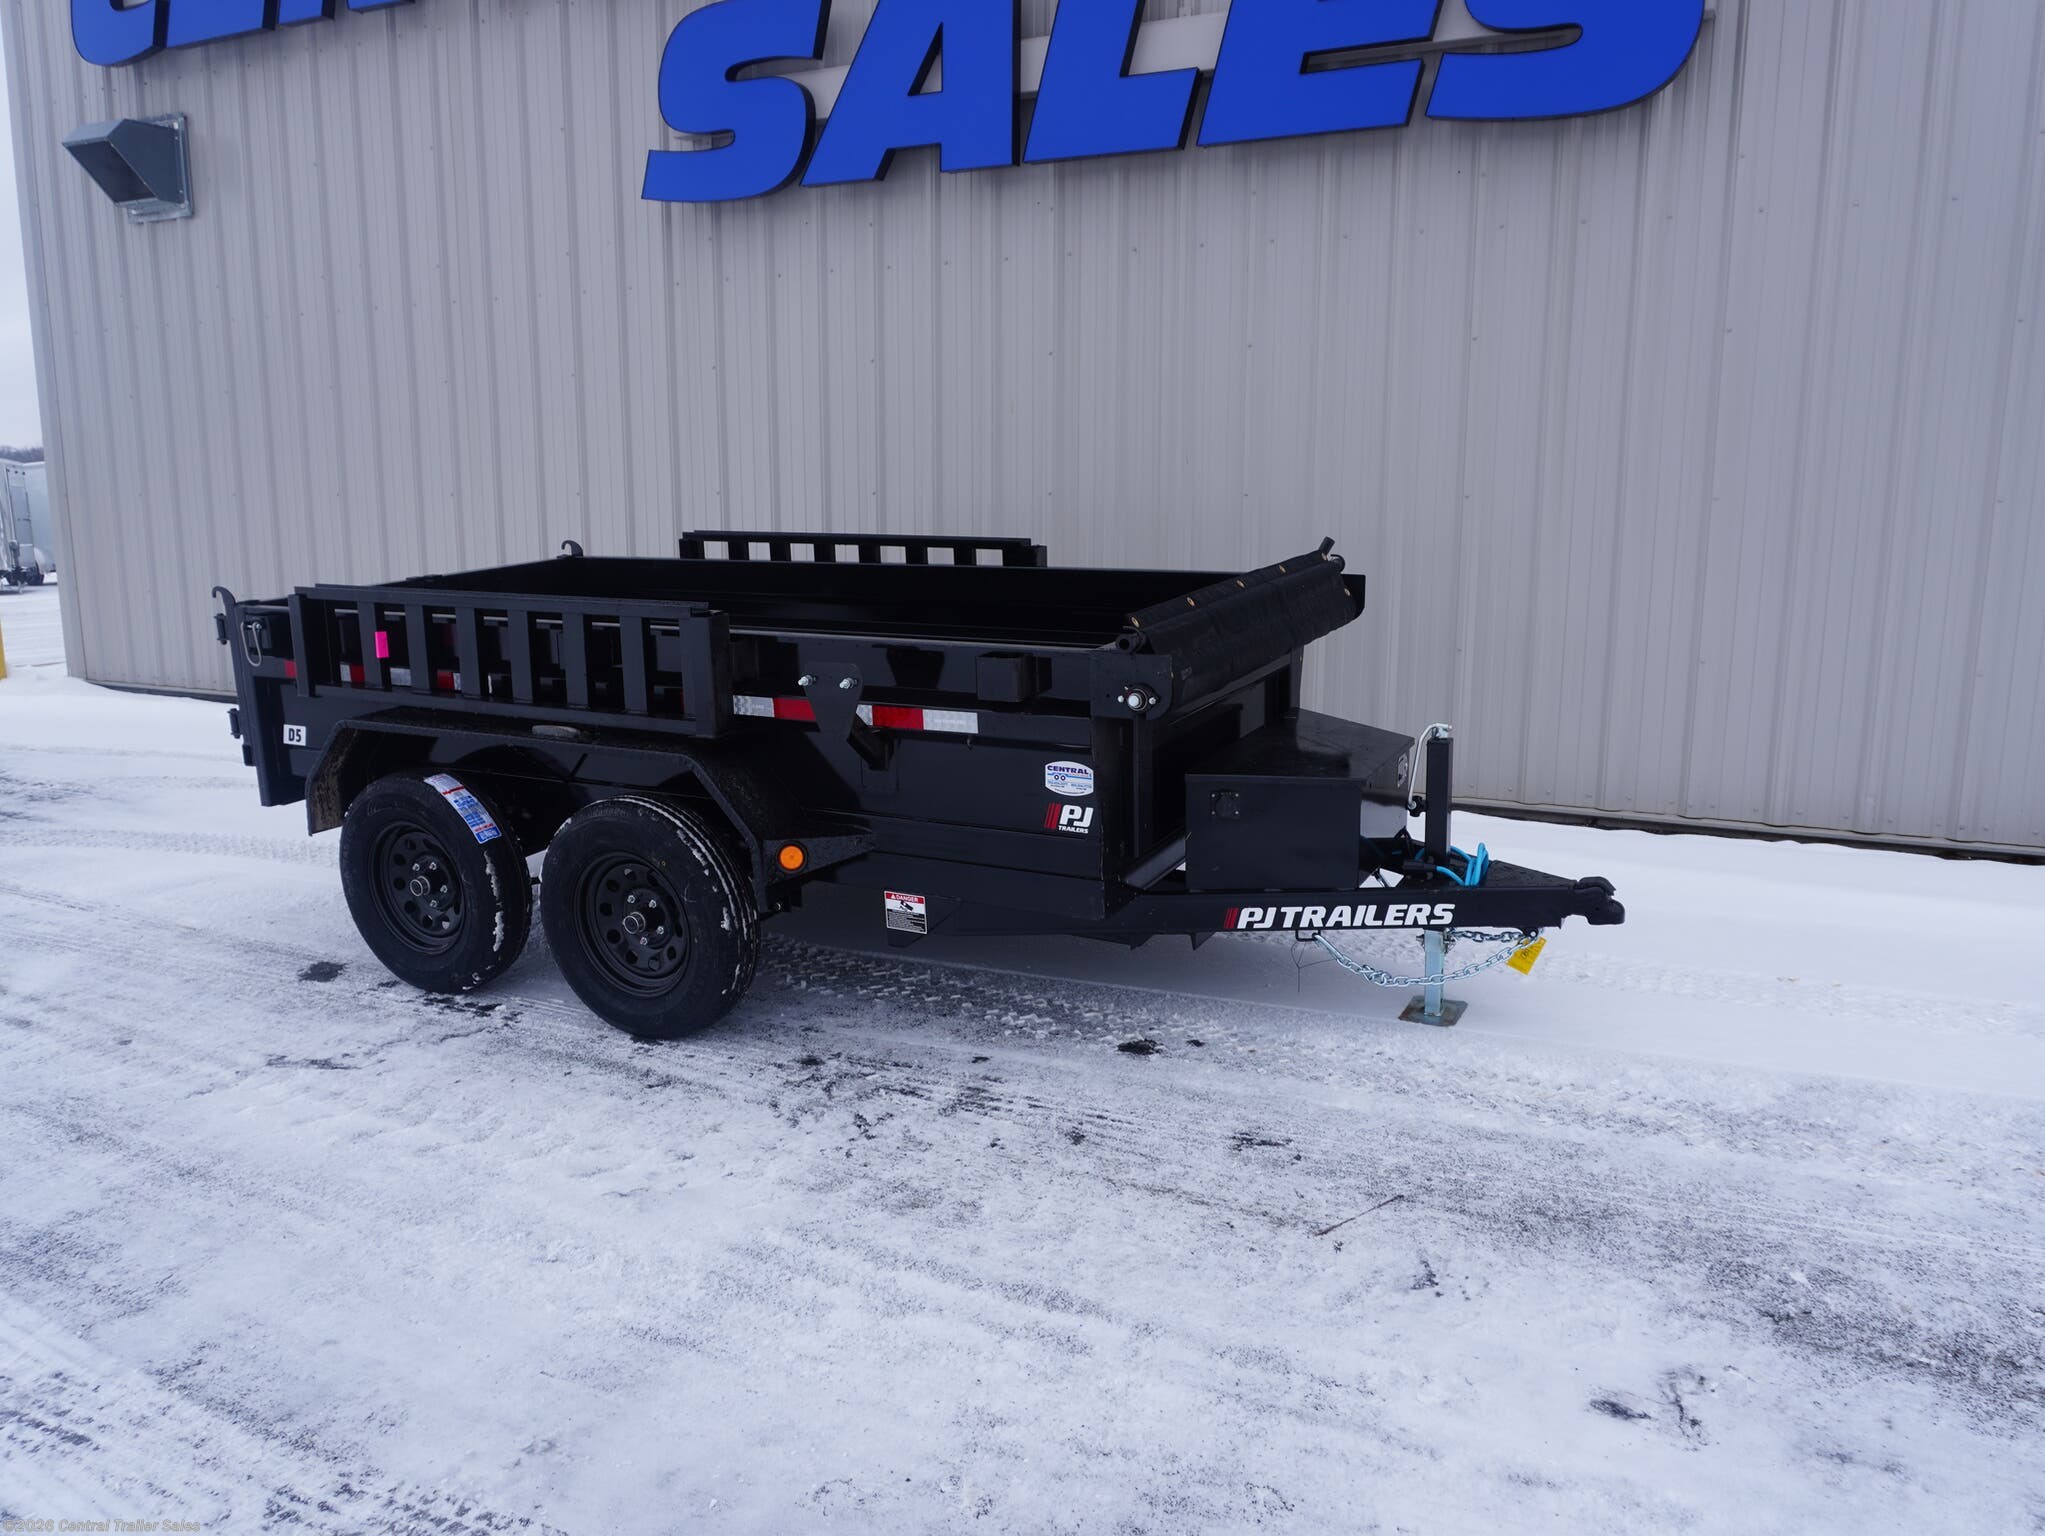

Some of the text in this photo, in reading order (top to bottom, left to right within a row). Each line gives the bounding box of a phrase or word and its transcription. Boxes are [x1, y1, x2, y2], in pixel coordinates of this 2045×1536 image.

[288, 727, 302, 743] D5
[1047, 765, 1089, 775] CENTRAL
[1059, 804, 1094, 828] PJ
[1058, 825, 1089, 834] TRAILERS
[896, 894, 919, 904] DANGER
[1237, 903, 1456, 930] PJ TRAILERS
